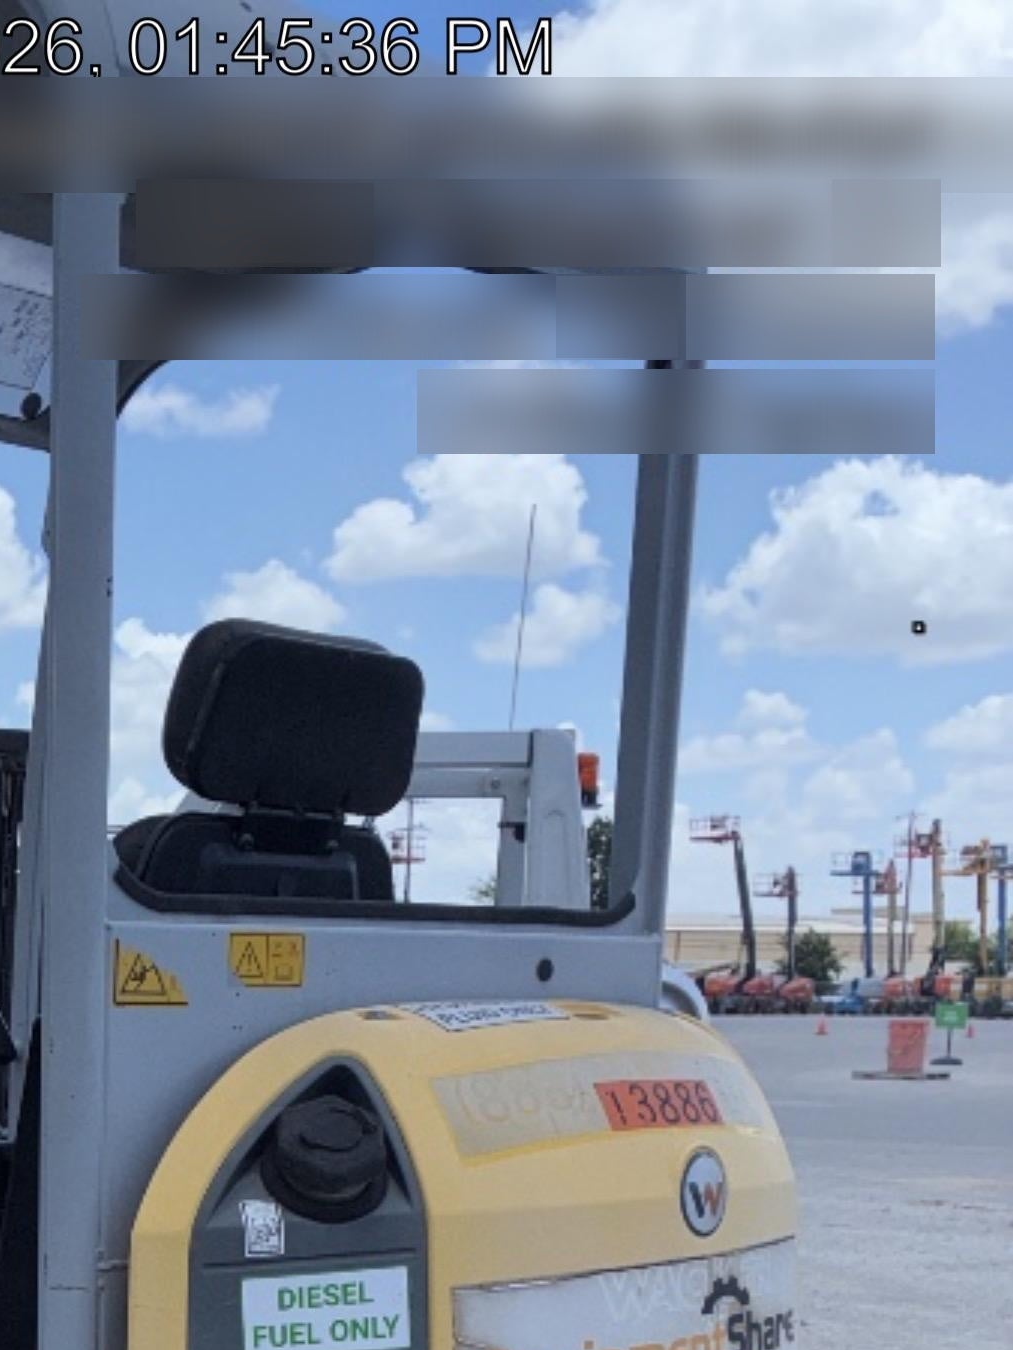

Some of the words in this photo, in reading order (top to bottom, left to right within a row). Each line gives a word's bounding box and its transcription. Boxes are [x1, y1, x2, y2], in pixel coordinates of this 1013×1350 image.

[604, 1081, 720, 1126] 13886
[276, 1280, 375, 1311] DIESEL
[252, 1322, 322, 1349] FUEL
[329, 1313, 400, 1342] ONLY
